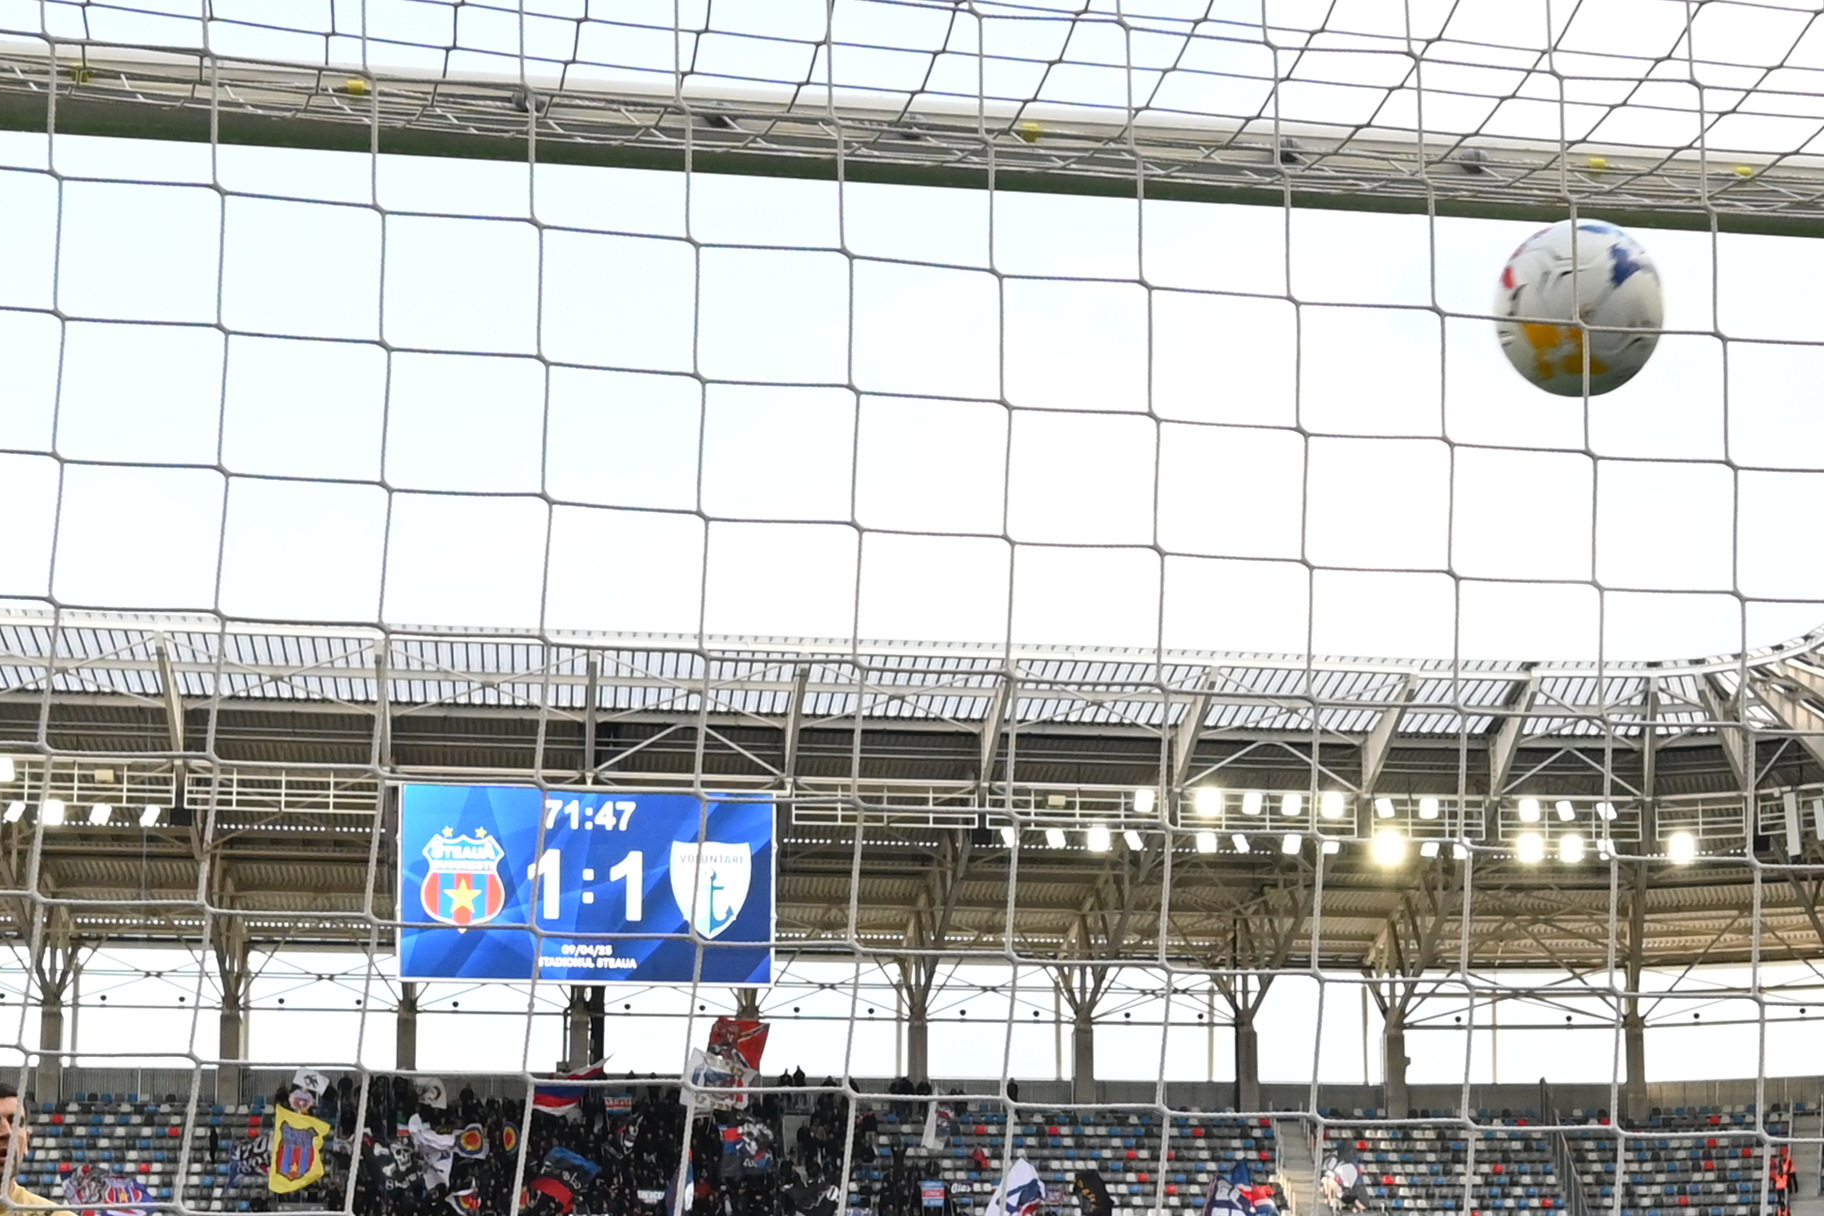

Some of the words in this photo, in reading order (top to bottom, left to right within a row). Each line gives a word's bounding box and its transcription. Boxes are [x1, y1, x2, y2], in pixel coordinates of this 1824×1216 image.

[544, 799, 637, 832] 71:47
[679, 854, 744, 864] VOUNTARI
[596, 957, 638, 969] STEAUA
